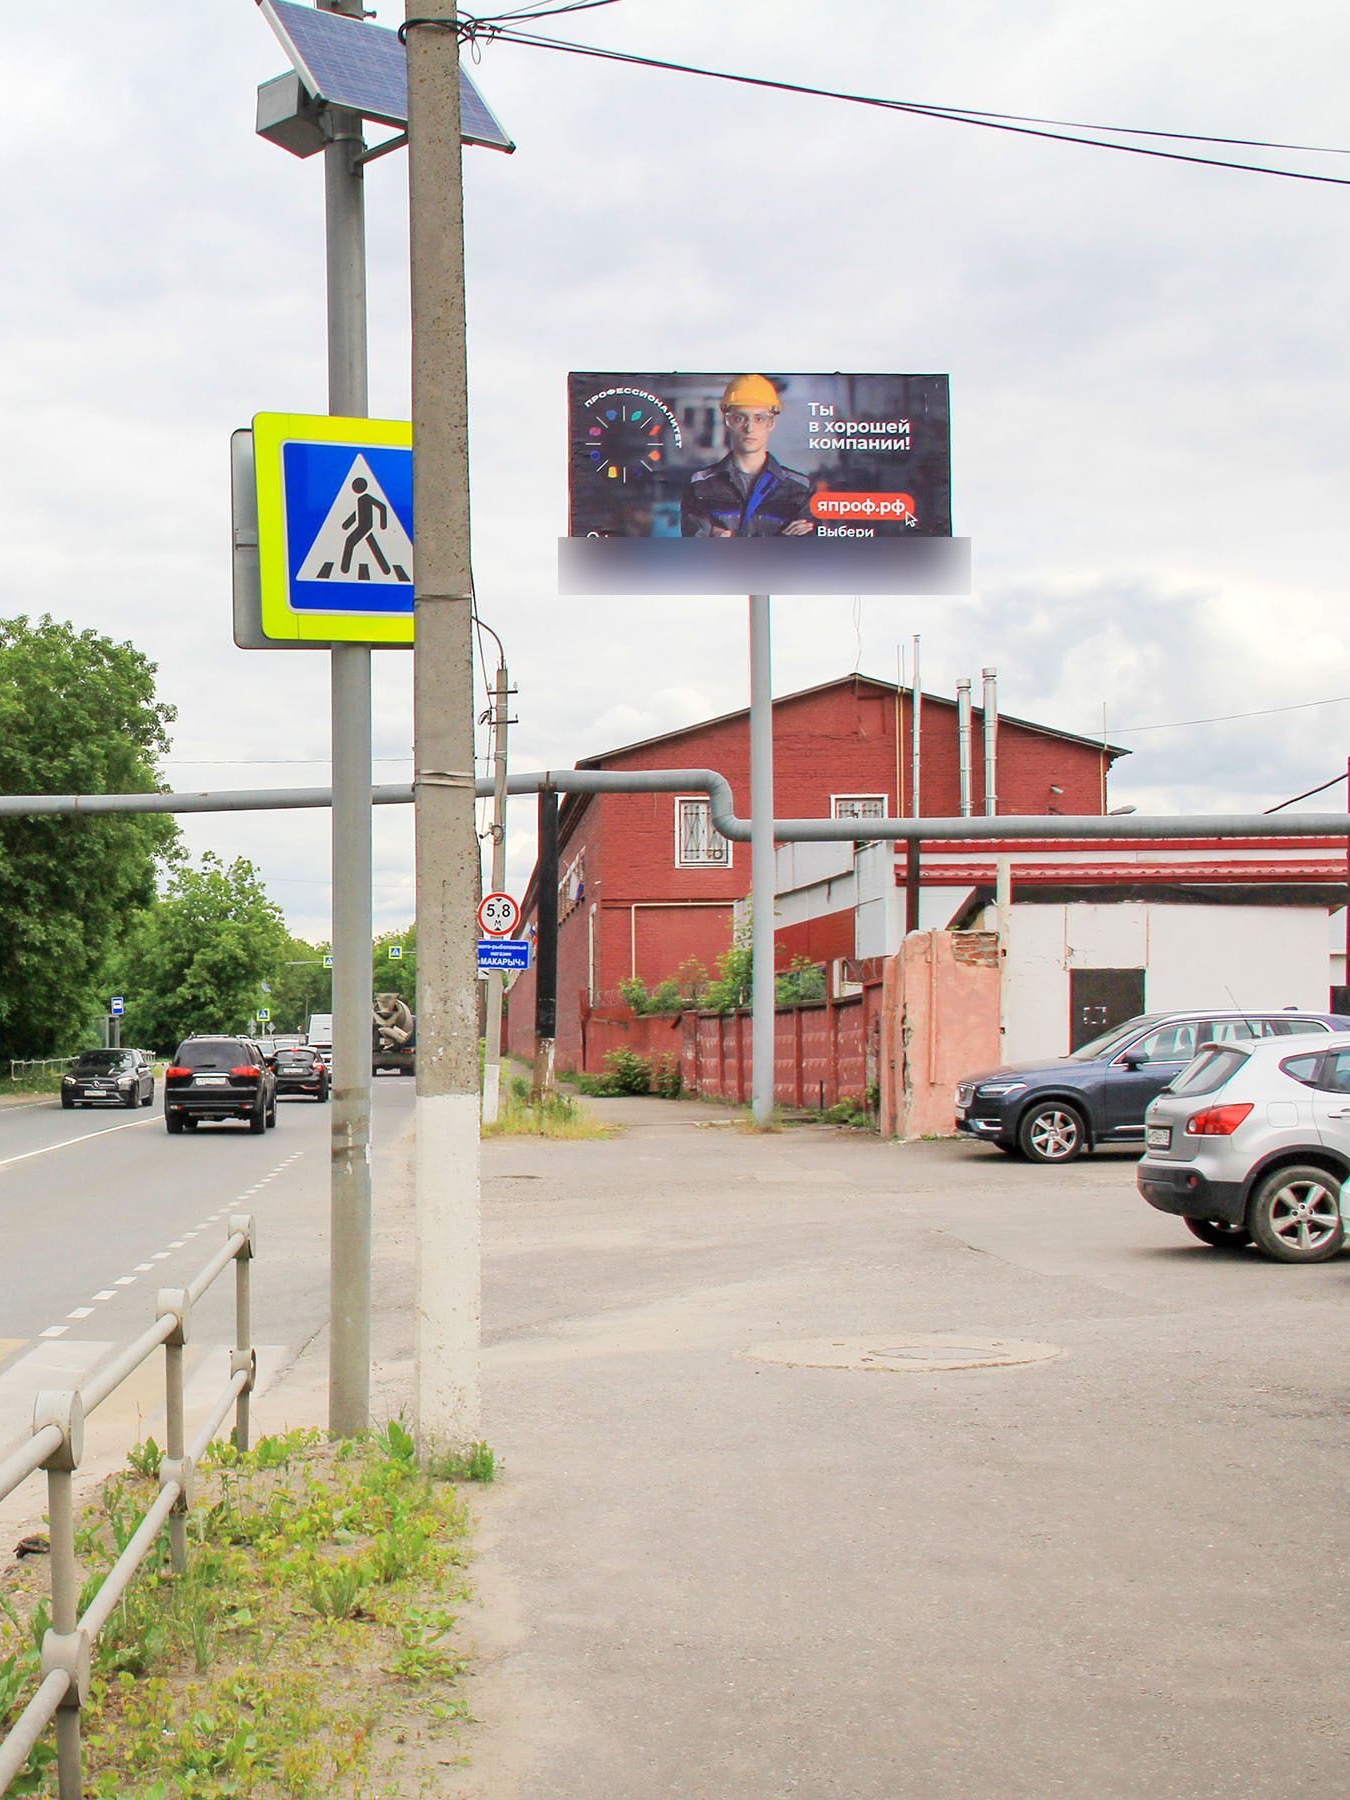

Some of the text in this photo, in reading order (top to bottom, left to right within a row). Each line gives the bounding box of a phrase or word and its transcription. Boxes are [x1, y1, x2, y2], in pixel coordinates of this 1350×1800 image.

[807, 402, 834, 416] Ты
[584, 387, 682, 448] ПРОФЕССИОНАЛИТЕТ
[809, 419, 910, 436] в хорошей
[809, 436, 911, 450] компании!
[817, 498, 905, 515] япроф.рф
[817, 525, 874, 537] Выбери
[486, 904, 511, 918] 5,8
